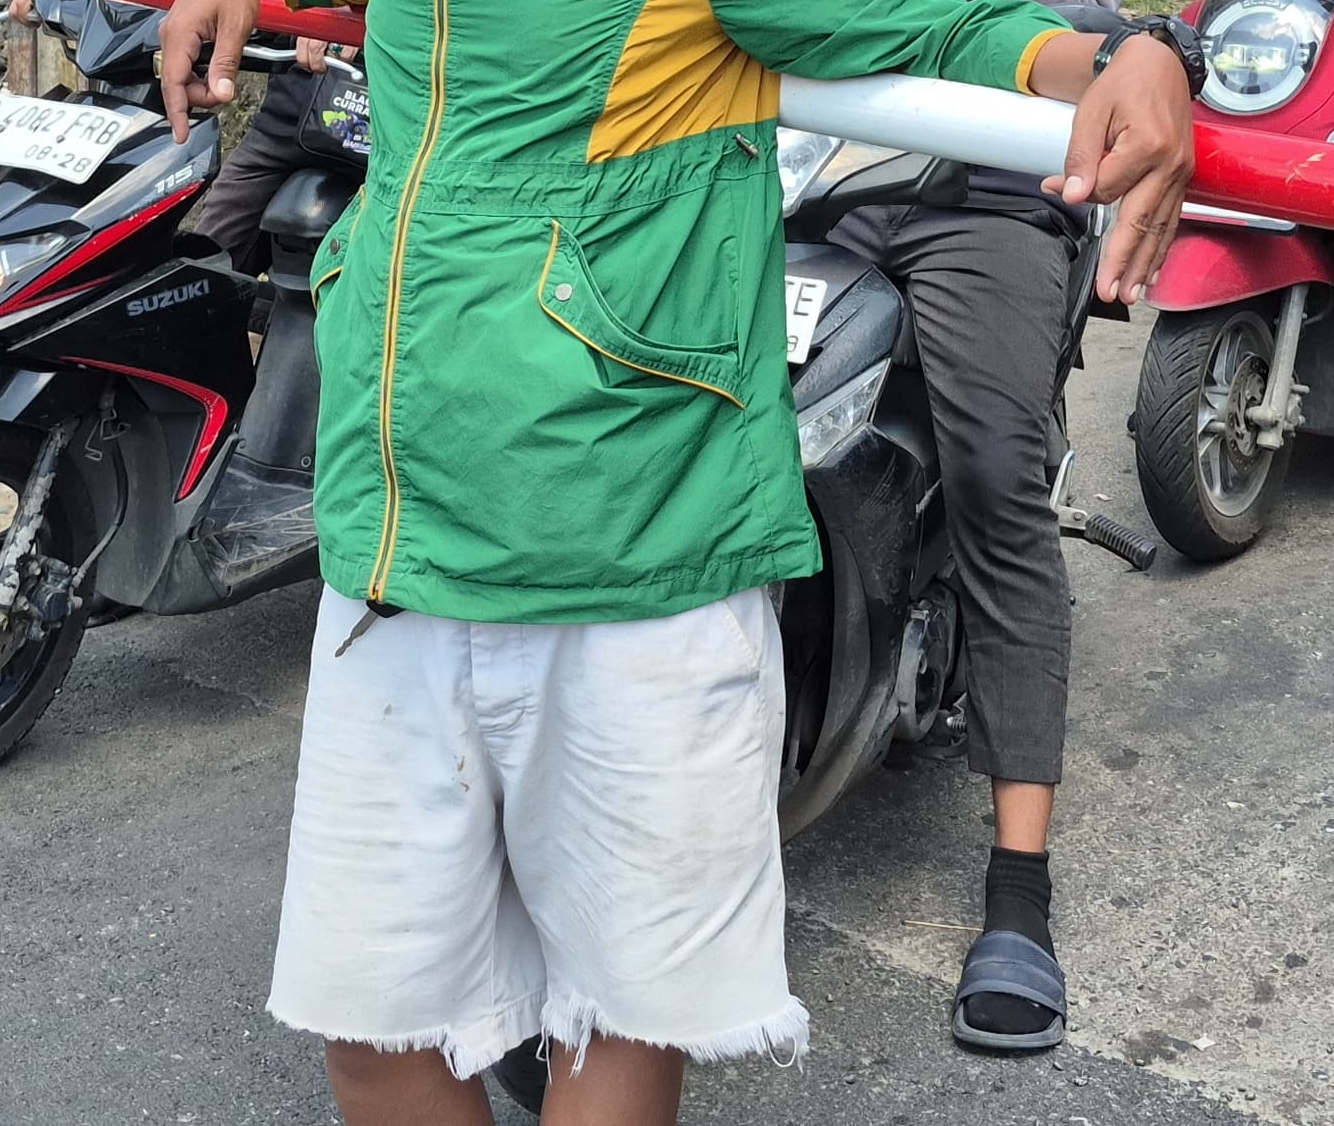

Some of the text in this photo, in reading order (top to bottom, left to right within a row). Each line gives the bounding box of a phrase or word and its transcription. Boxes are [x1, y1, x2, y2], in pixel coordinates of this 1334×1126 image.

[333, 96, 370, 117] CURRA
[63, 112, 121, 145] FRB
[155, 164, 193, 194] 115
[126, 278, 211, 317] SUZUKI
